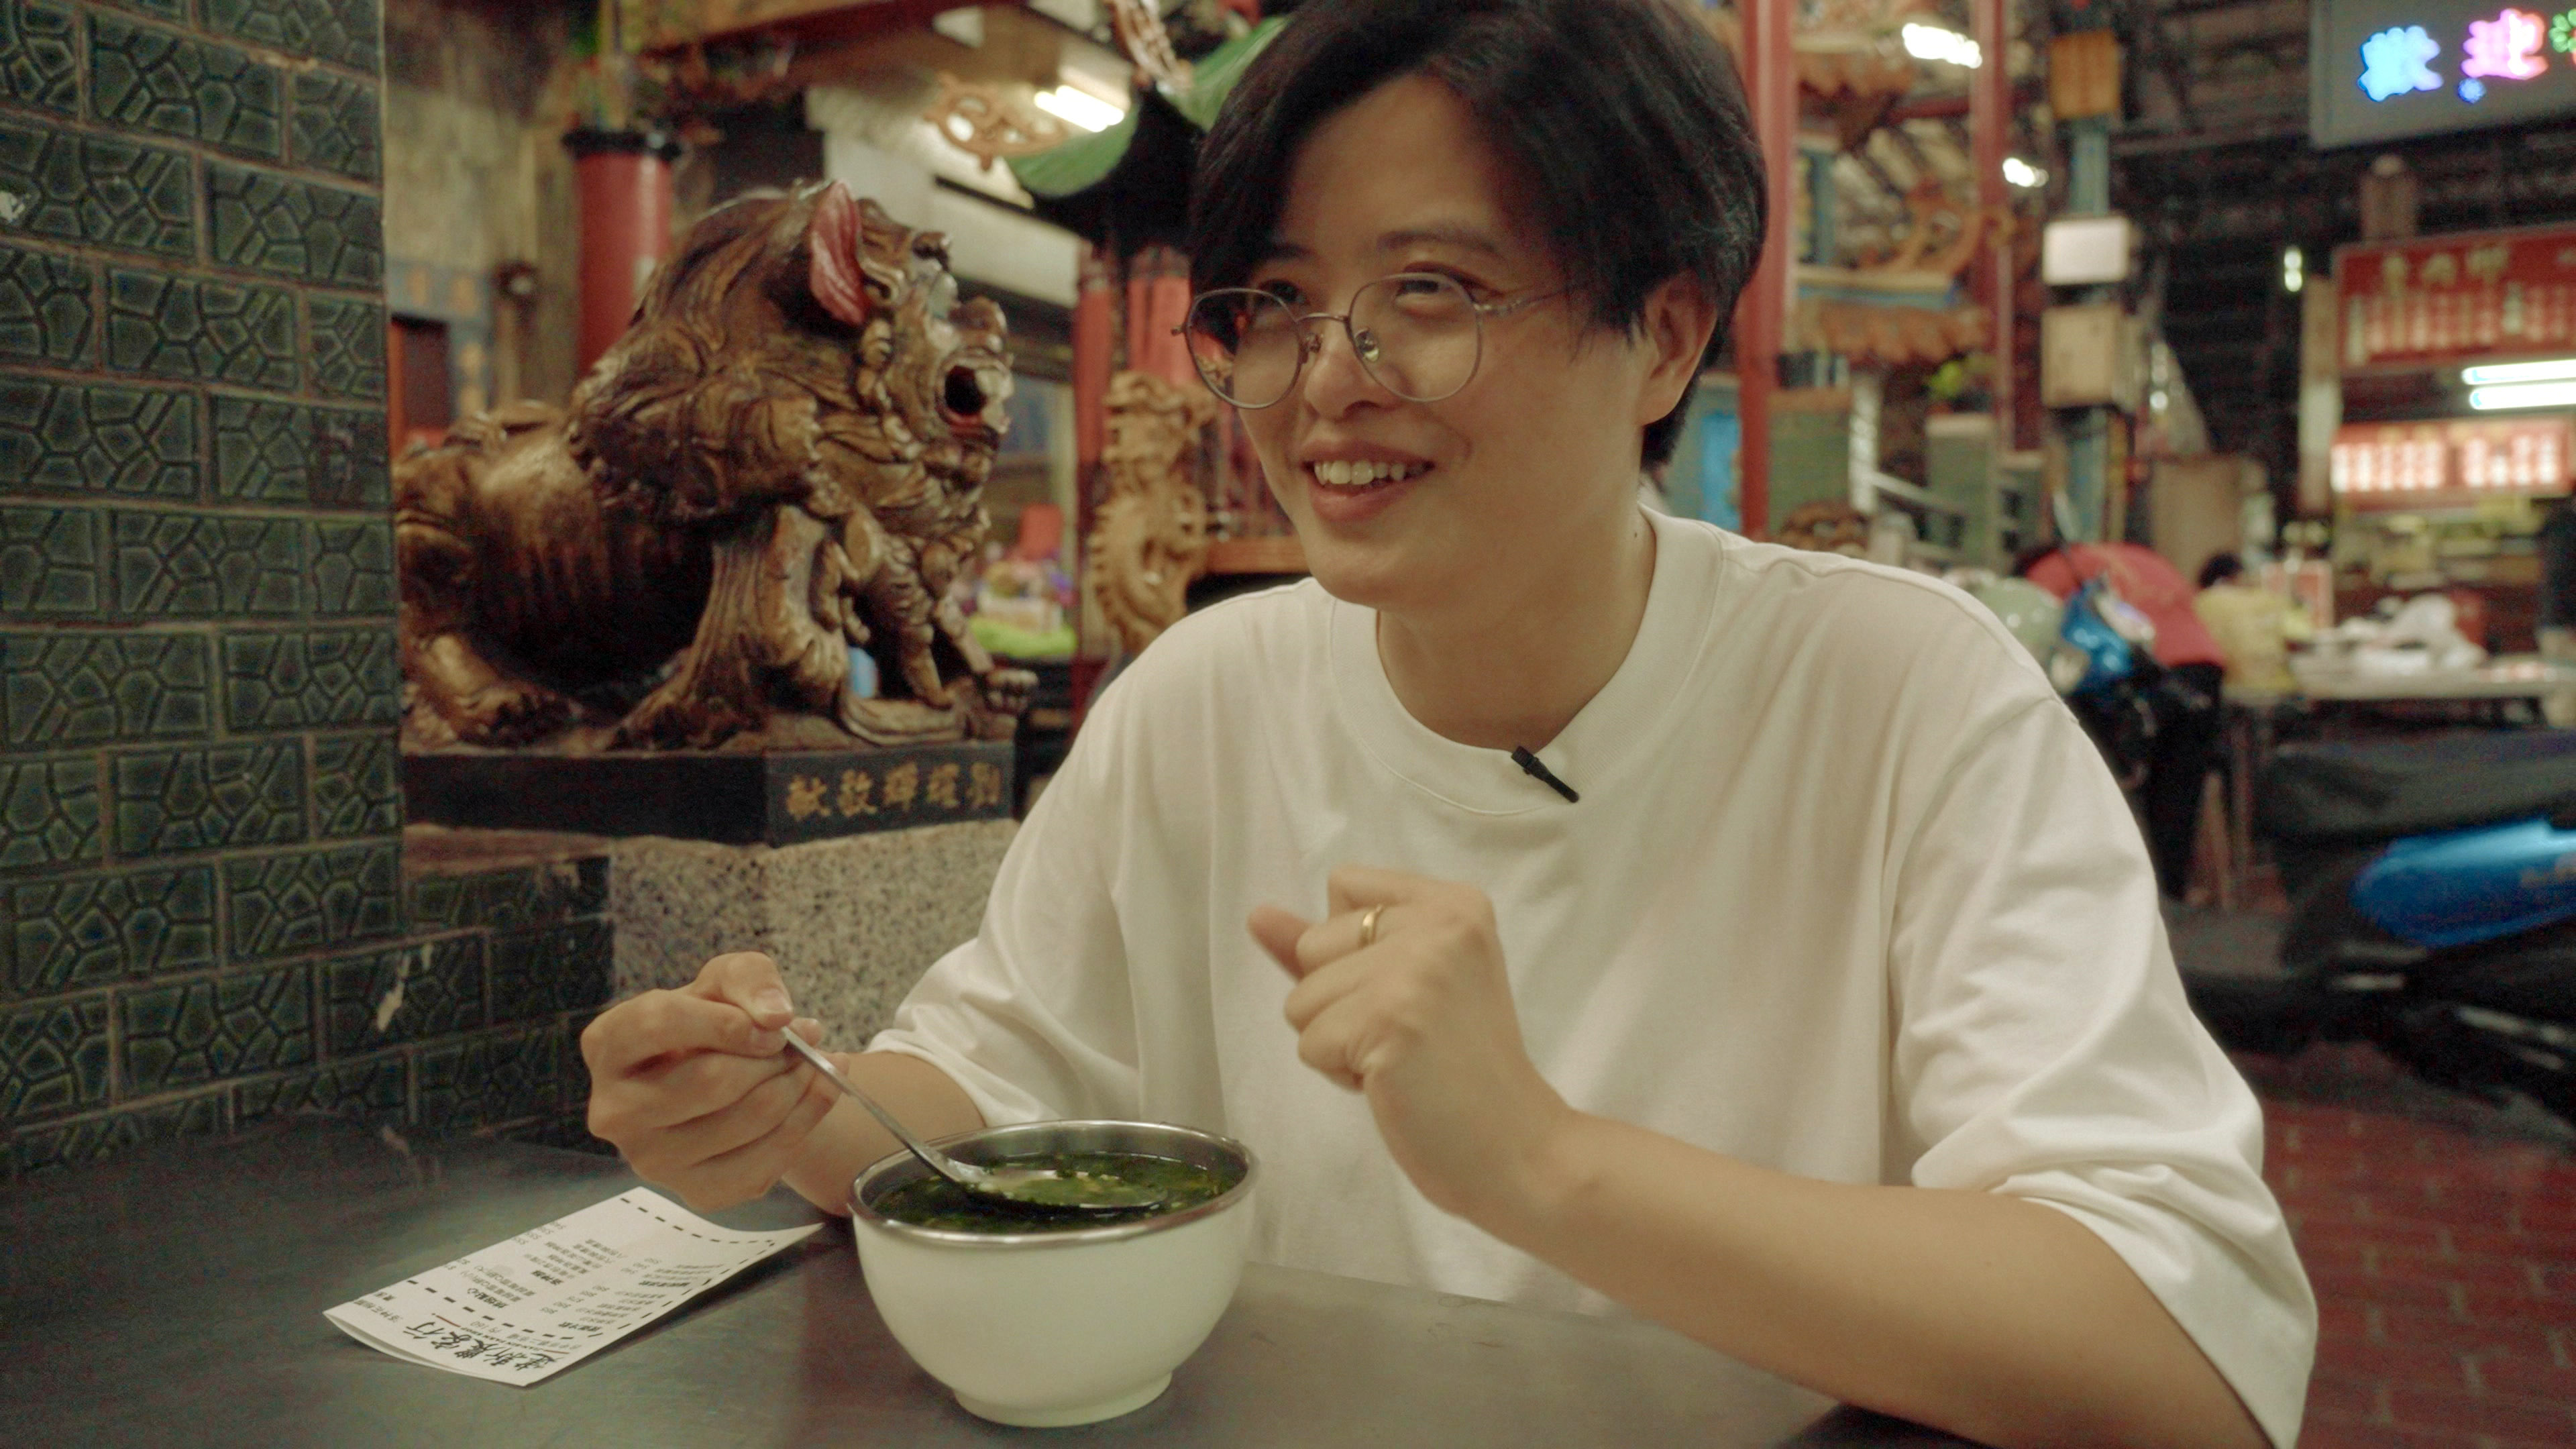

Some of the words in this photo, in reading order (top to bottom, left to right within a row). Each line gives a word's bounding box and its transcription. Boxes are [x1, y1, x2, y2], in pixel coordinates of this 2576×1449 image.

[403, 1322, 560, 1371] 建新農家行
